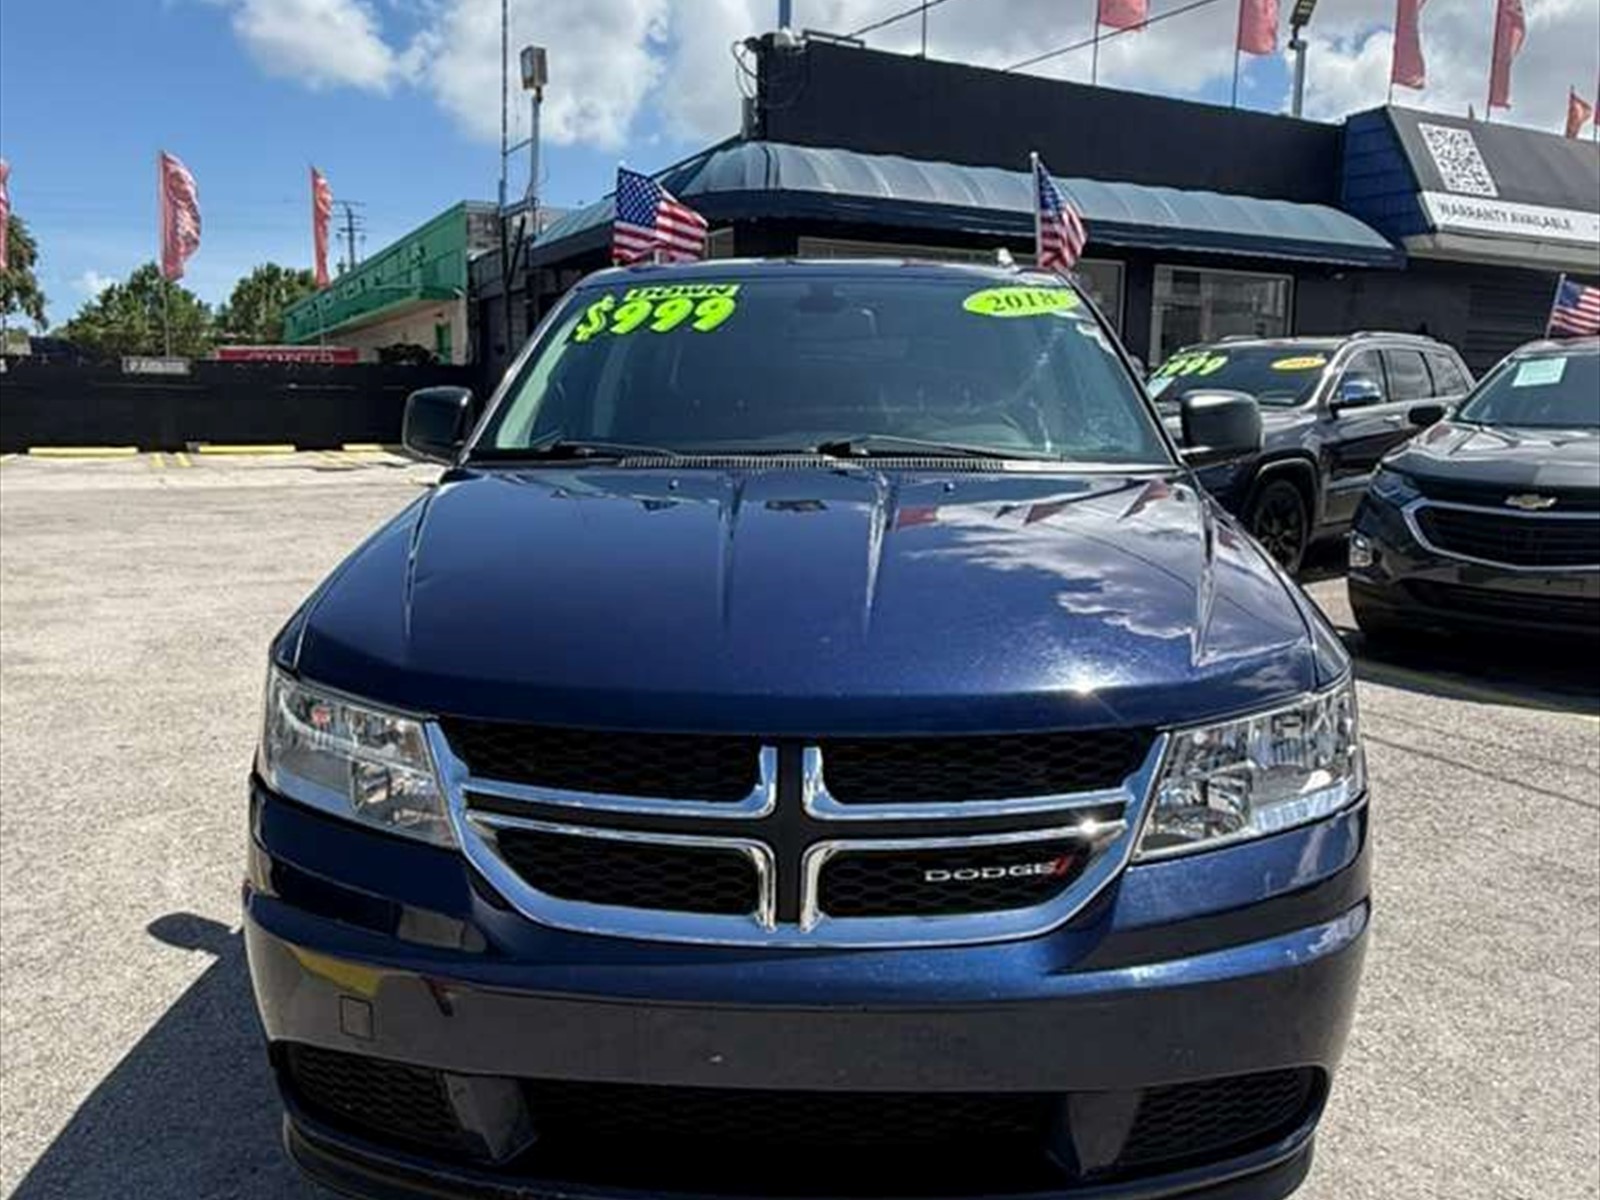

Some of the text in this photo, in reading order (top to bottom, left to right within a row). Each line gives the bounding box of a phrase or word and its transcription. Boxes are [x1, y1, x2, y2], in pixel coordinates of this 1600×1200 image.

[988, 293, 1059, 312] 2018
[574, 295, 737, 342] $999
[924, 863, 1054, 882] DODGE
